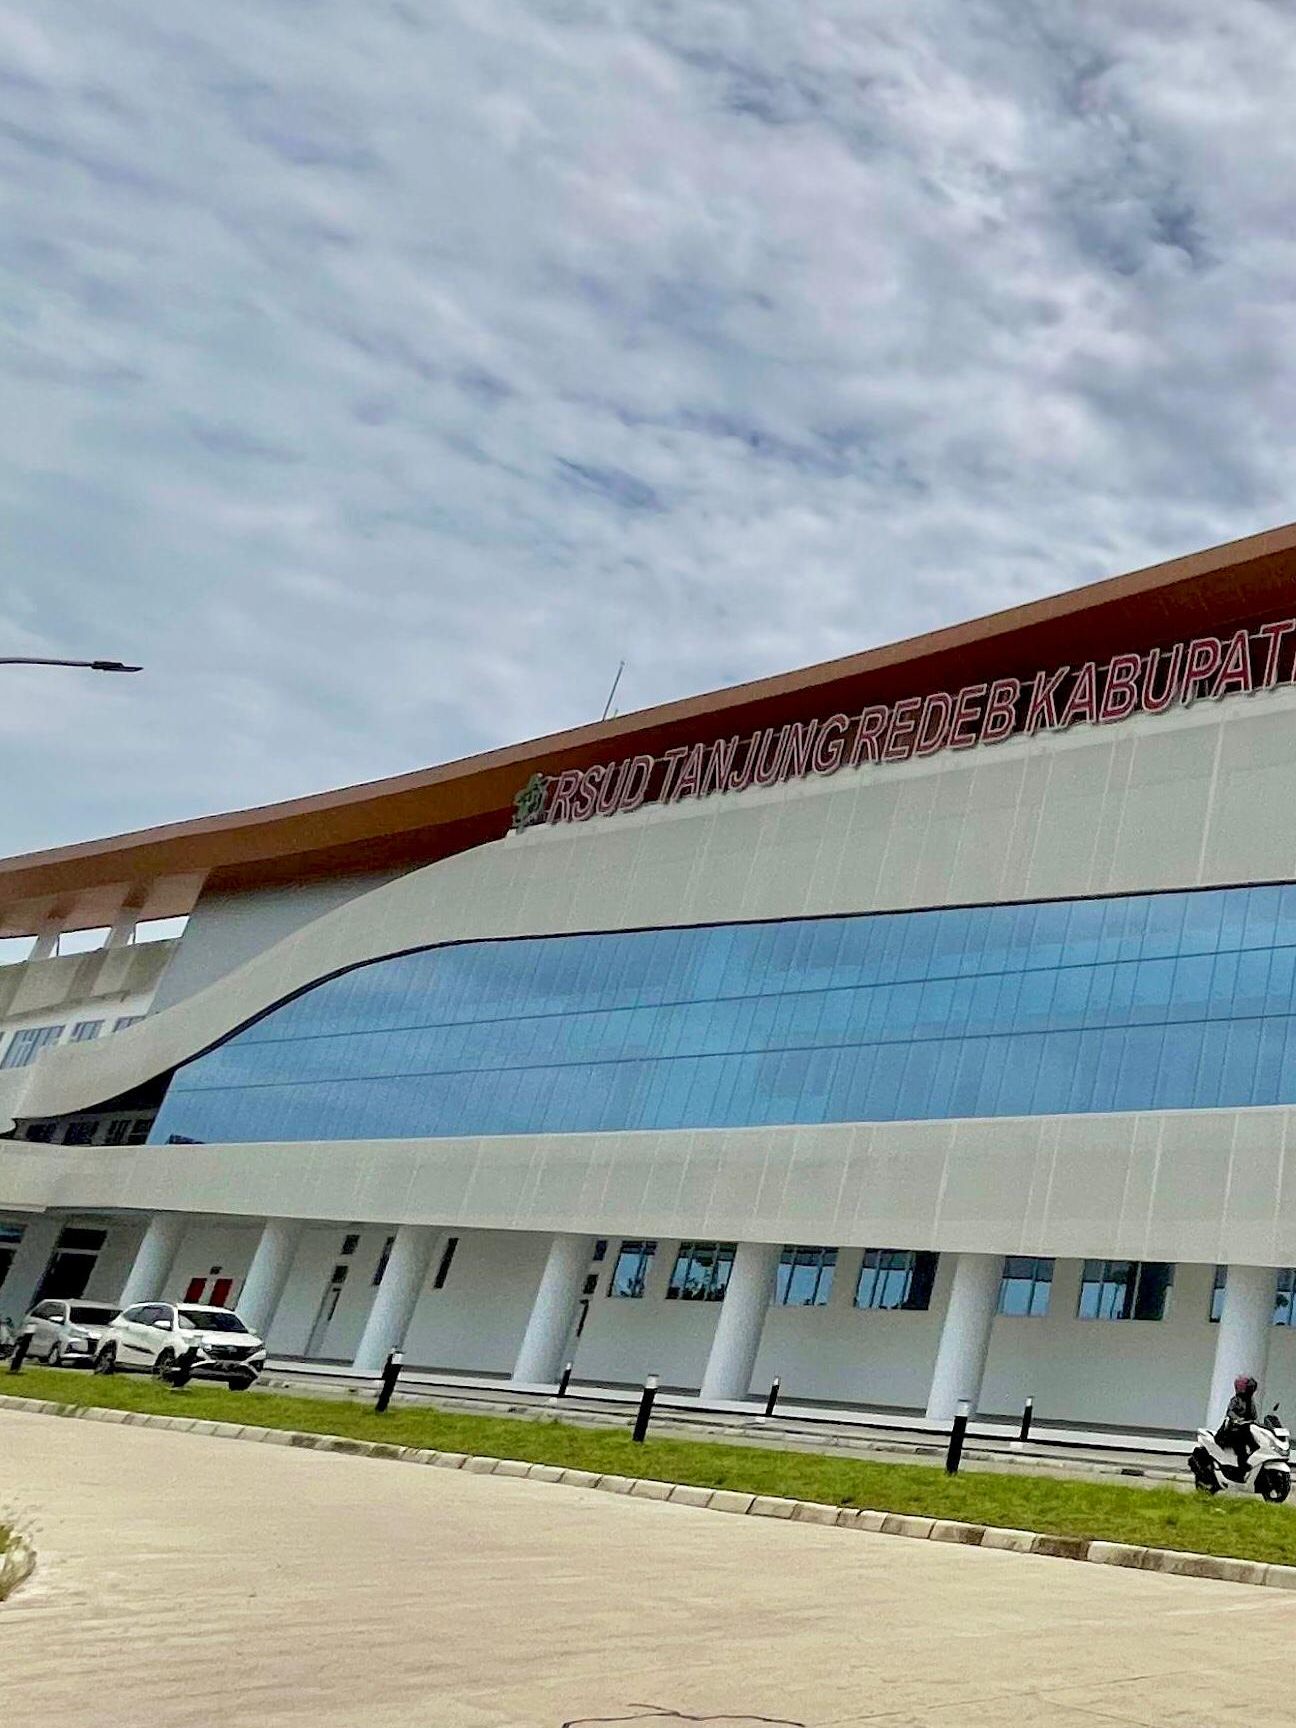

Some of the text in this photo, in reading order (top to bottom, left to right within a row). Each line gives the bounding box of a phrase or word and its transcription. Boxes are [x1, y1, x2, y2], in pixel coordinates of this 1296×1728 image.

[546, 752, 655, 823] RSUD
[656, 712, 850, 804] TANJUNG
[850, 676, 1021, 766] REDEB
